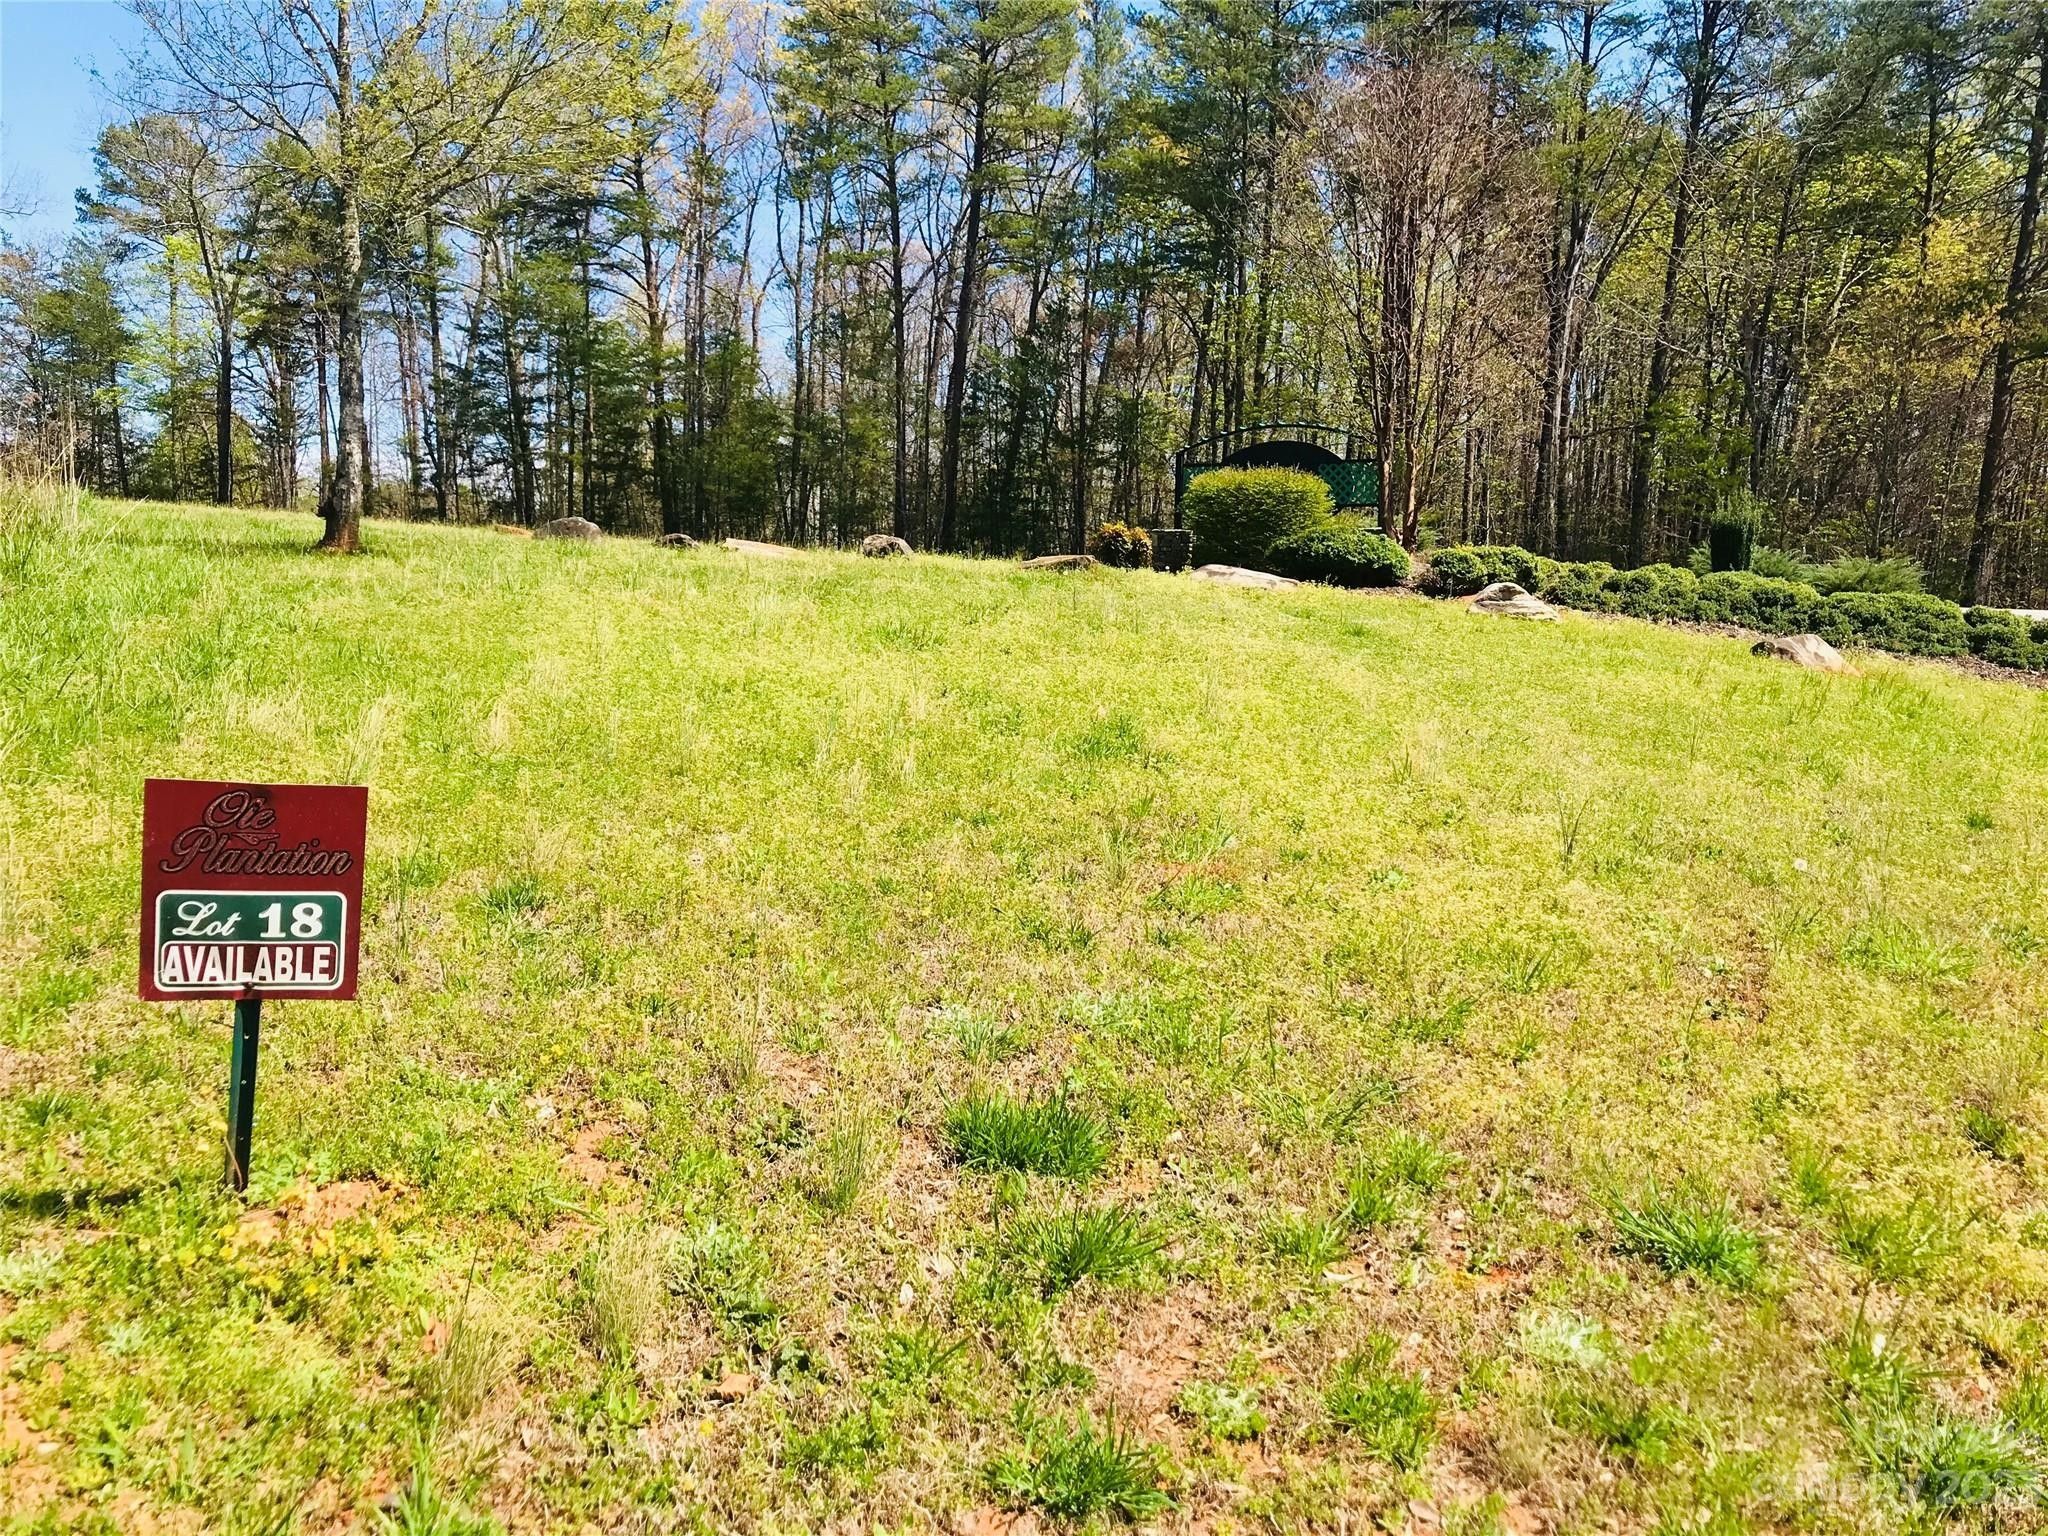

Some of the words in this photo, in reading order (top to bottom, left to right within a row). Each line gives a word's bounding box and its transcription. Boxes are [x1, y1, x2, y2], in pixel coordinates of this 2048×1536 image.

[160, 825, 354, 876] Plantation
[172, 900, 242, 937] Lot
[258, 902, 323, 939] 18
[163, 945, 331, 983] AVAILABLE
